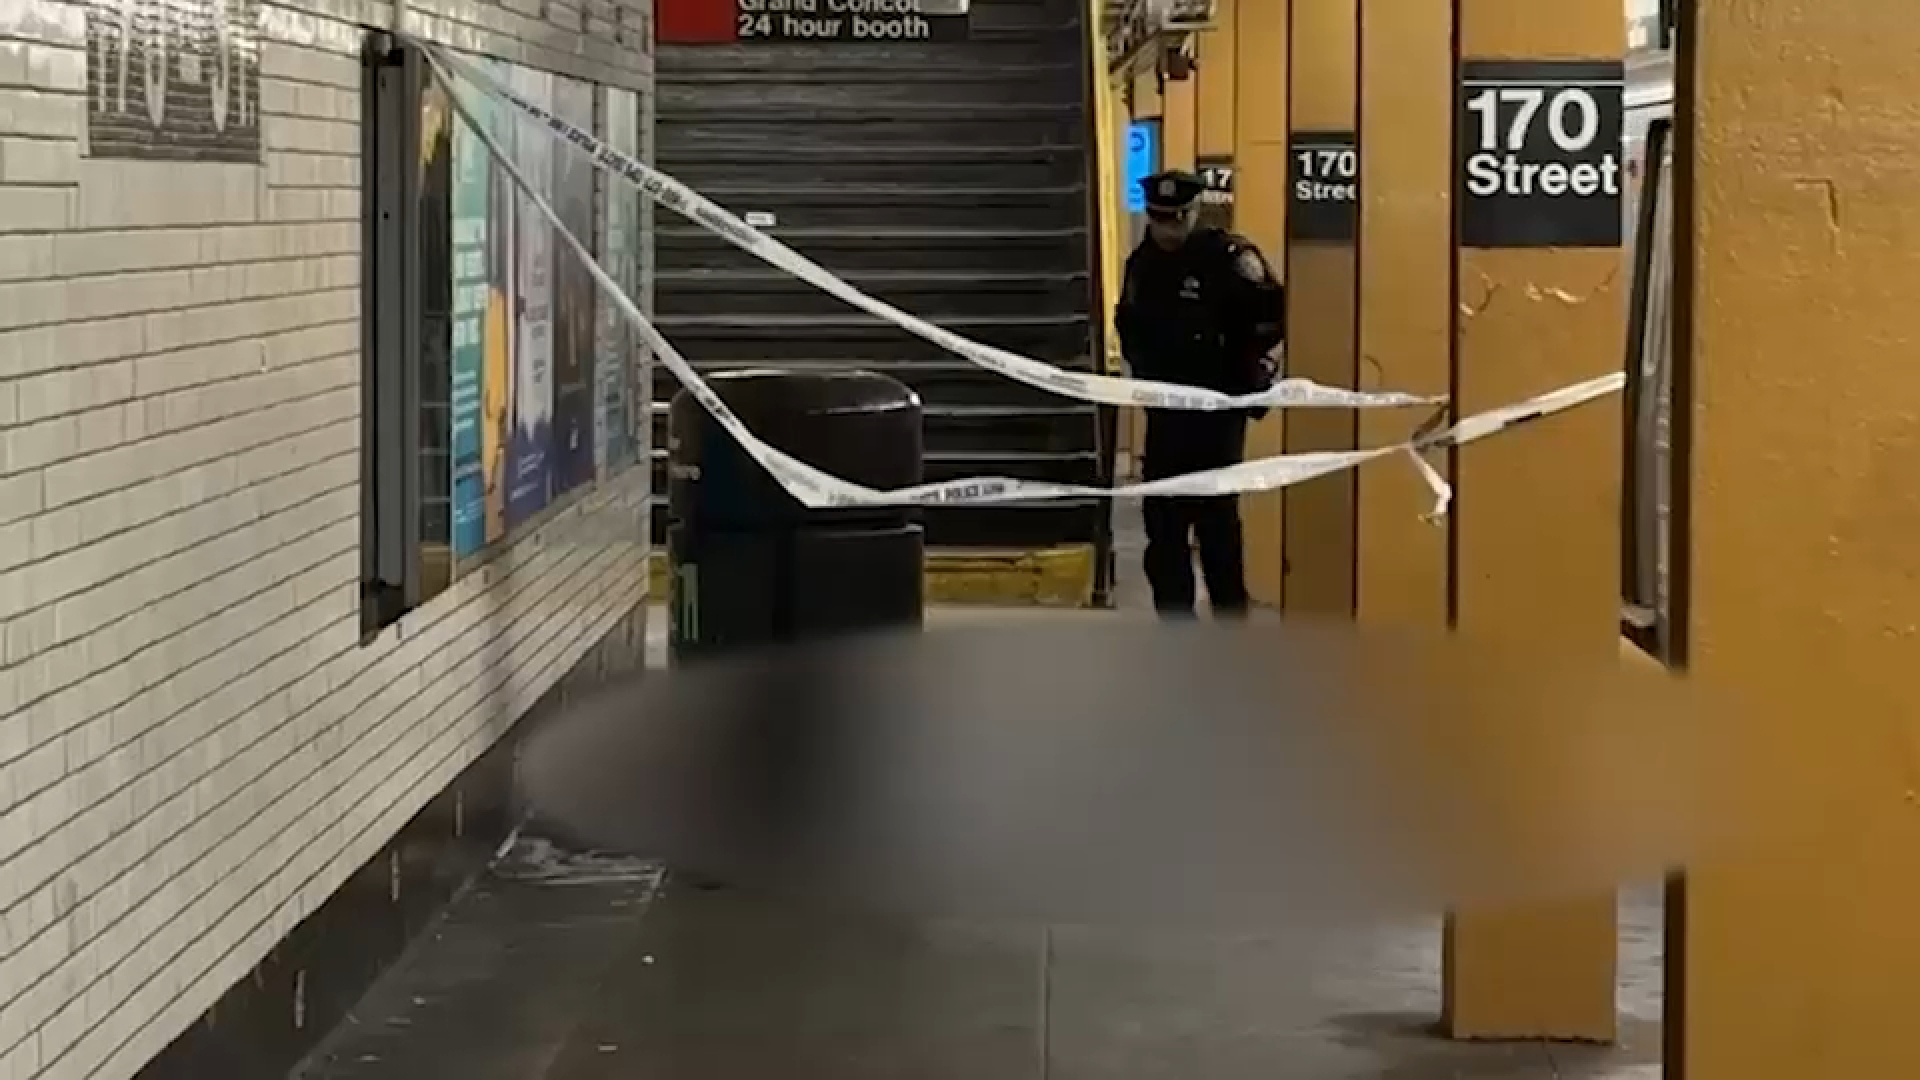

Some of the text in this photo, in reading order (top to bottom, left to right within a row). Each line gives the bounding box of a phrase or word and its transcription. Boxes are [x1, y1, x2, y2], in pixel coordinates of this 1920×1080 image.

[738, 14, 929, 38] 24 hour booth
[1467, 88, 1599, 151] 170
[1298, 151, 1356, 177] 170
[1466, 153, 1619, 196] Street
